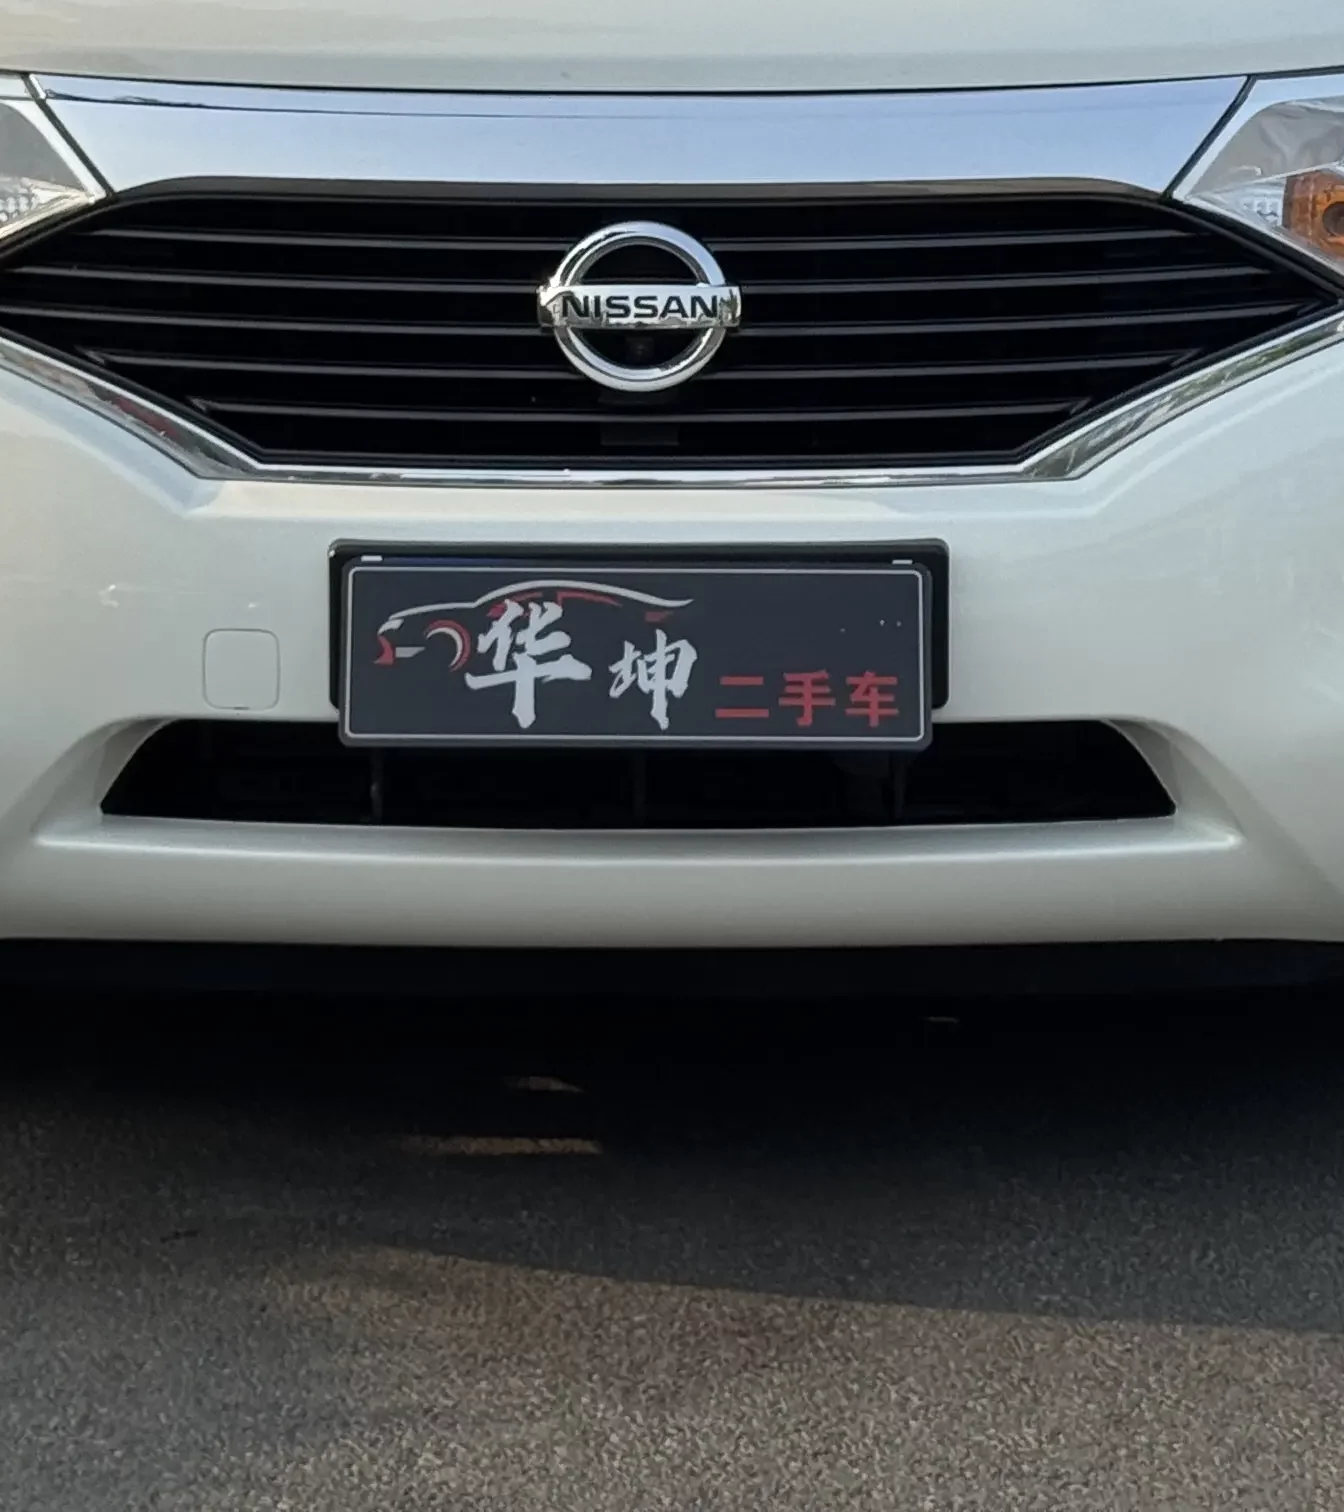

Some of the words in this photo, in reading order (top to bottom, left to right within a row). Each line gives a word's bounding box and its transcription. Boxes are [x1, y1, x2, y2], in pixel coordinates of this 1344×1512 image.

[561, 295, 719, 319] NISSAN
[465, 598, 698, 730] 华坤
[715, 671, 900, 727] 二手车
